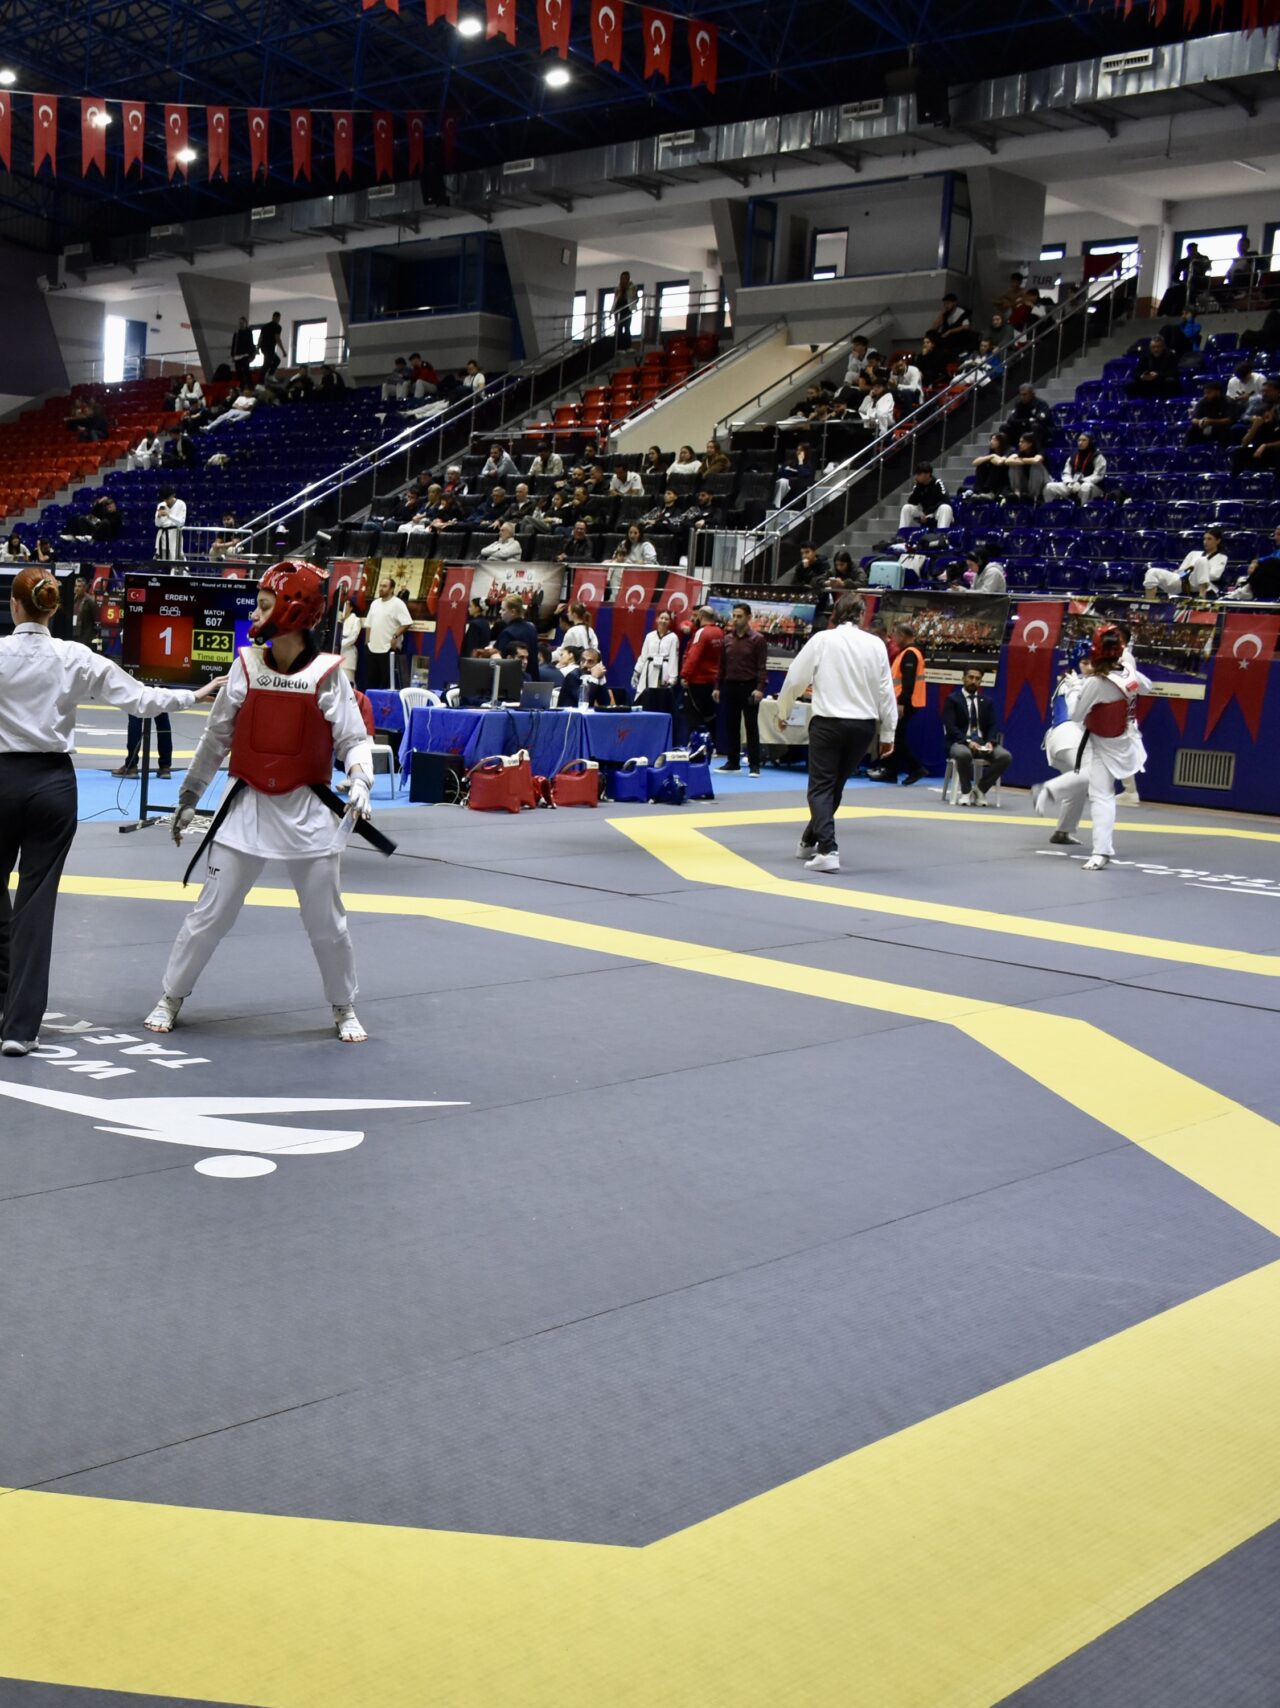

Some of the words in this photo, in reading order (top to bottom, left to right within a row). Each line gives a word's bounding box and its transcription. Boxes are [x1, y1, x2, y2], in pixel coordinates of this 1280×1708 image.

[107, 609, 115, 620] 5
[206, 618, 223, 627] 607
[159, 627, 173, 656] 1
[197, 634, 230, 650] 1:23
[273, 676, 308, 690] Daedo
